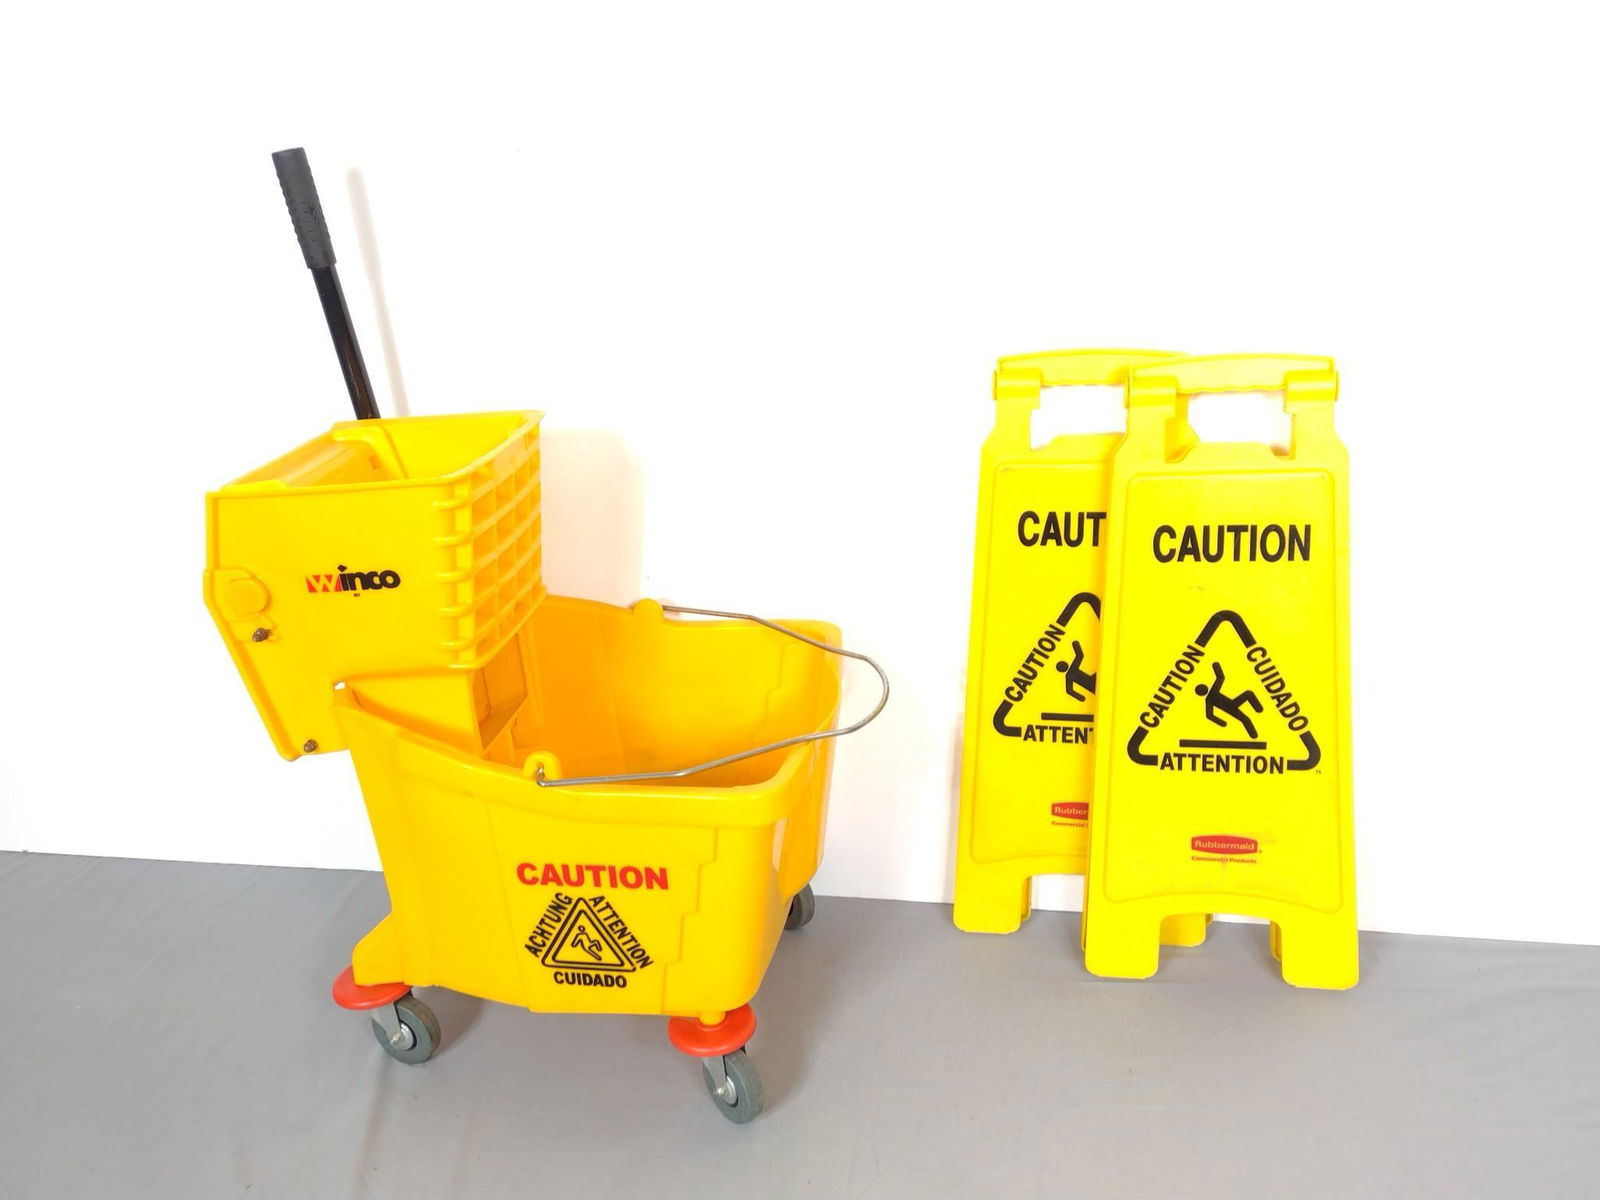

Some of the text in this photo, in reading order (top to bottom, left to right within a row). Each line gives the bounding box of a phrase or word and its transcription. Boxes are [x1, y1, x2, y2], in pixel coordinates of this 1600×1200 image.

[1152, 524, 1311, 563] CAUTION
[1004, 623, 1066, 702] CAUTION
[1139, 644, 1206, 728] CAUTION
[1246, 646, 1309, 731] CUIDADO
[1160, 752, 1284, 775] ATTENTION
[1194, 839, 1255, 851] Rubbermaid
[516, 862, 669, 890] CAUTION
[524, 892, 573, 958] ACHTUNG
[589, 895, 654, 969] ATTENTION
[553, 971, 628, 988] CUIDADO
